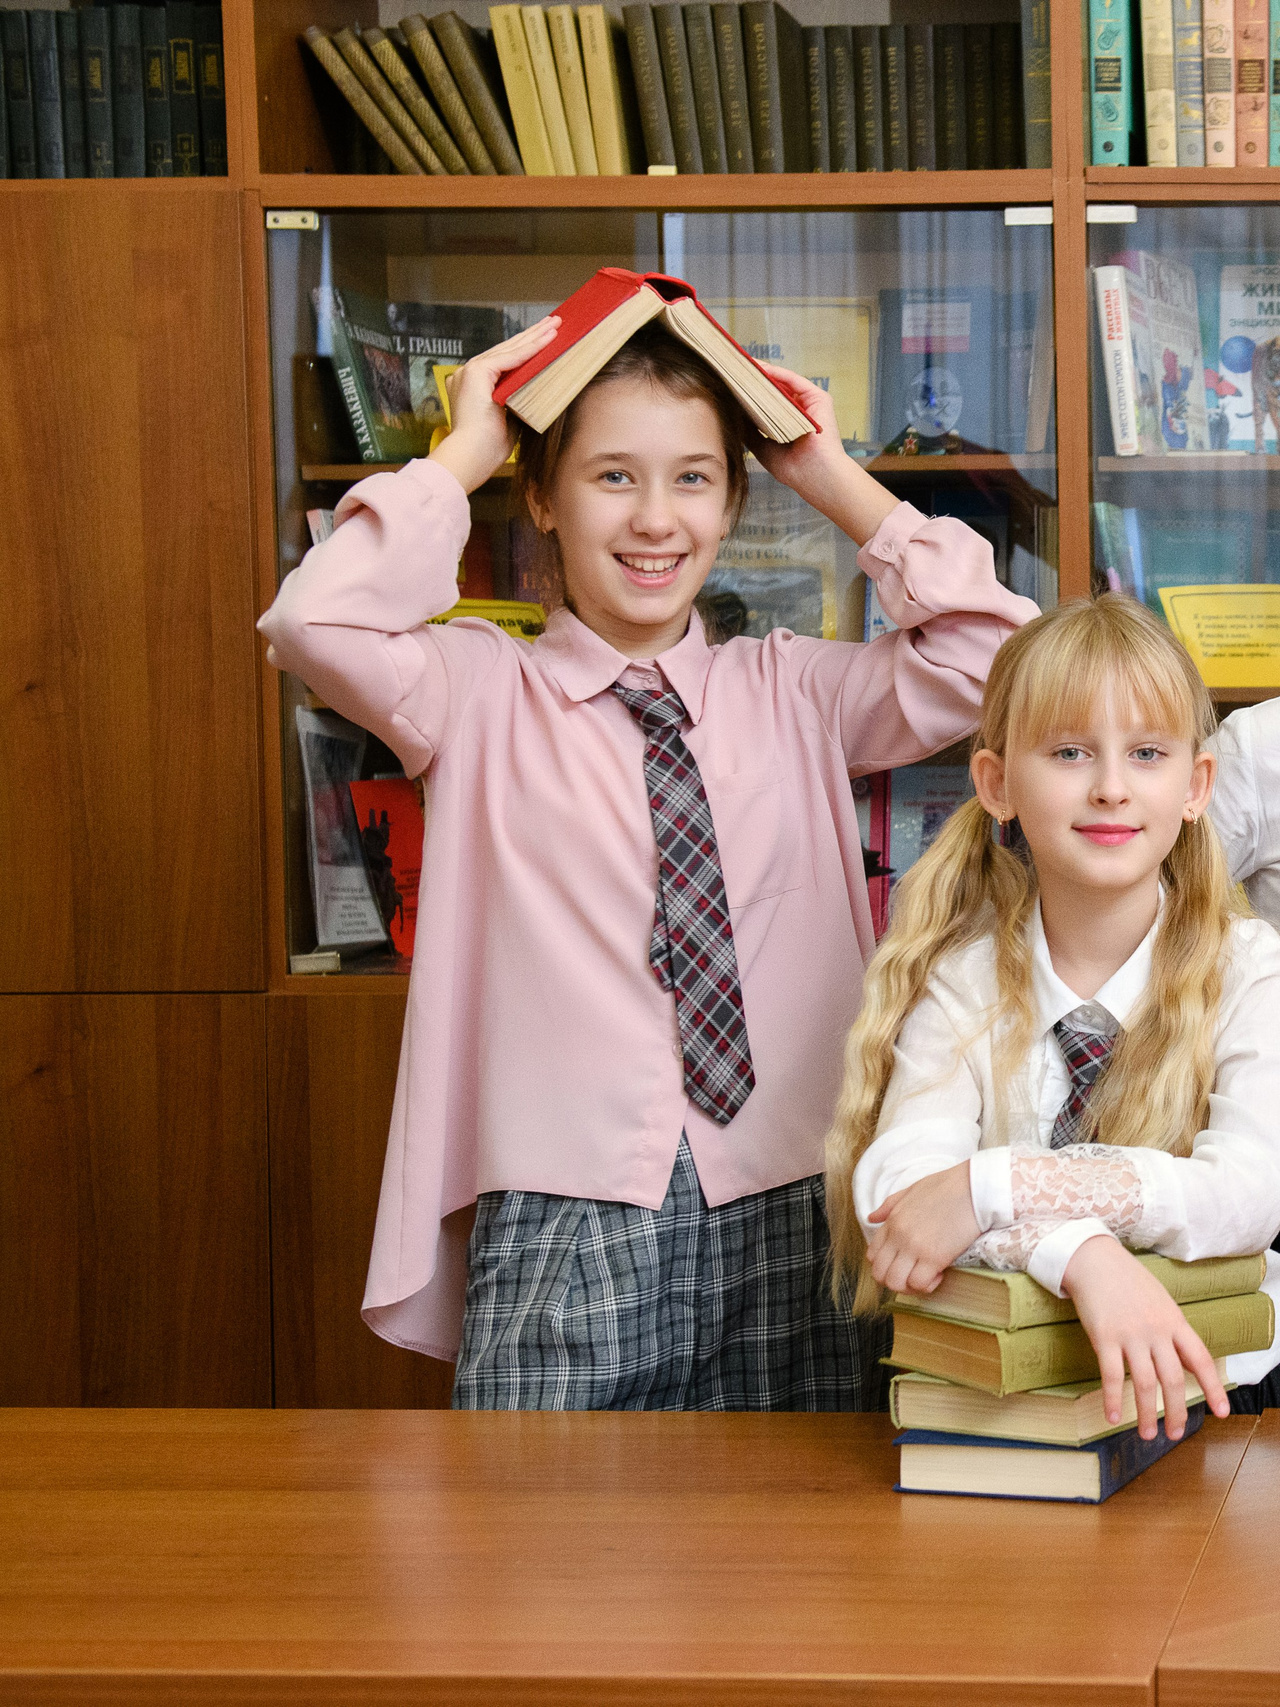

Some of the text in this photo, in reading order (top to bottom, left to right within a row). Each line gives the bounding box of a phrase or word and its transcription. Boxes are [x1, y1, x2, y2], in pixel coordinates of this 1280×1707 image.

[753, 22, 769, 91] ТОЛСТОЙ
[809, 46, 821, 111] ТОЛСТОЙ
[861, 46, 875, 146] ЛЕВ ТОЛСТОЙ
[887, 46, 900, 146] ЛЕВ ТОЛСТОЙ
[409, 336, 464, 357] ГРАНИН
[1102, 289, 1118, 342] Рассказы
[337, 366, 371, 445] КАЗАКЕВИЧ
